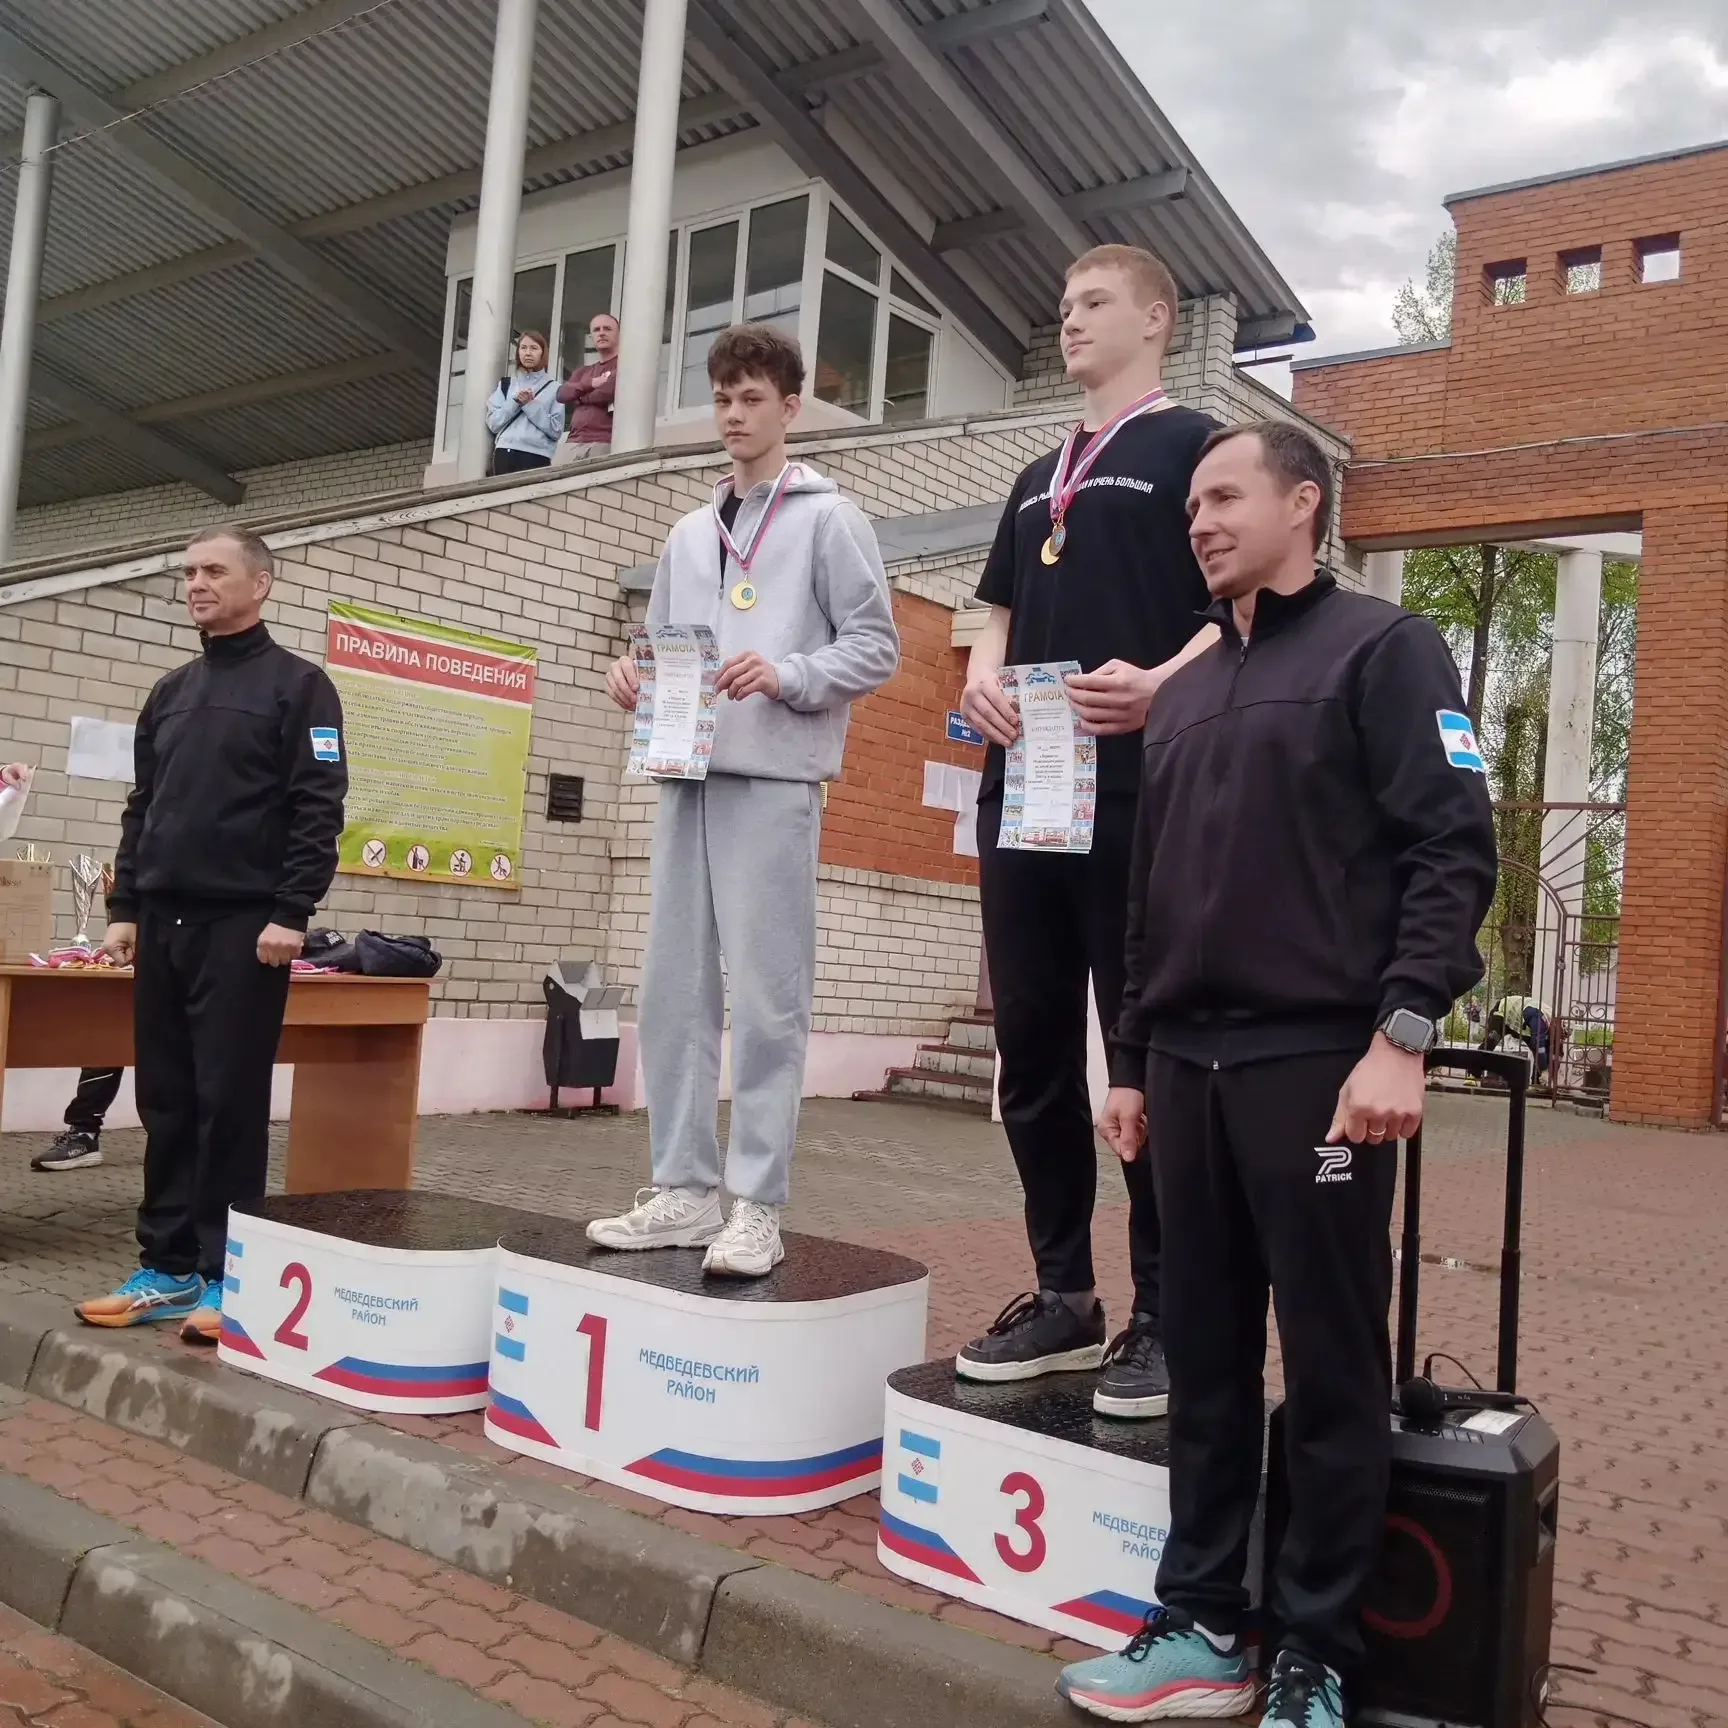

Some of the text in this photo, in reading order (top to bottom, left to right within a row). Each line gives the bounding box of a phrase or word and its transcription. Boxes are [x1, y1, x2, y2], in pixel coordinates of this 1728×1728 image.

[1093, 476, 1115, 487] ОЧЕНЬ
[1114, 476, 1154, 494] БОЛЬШАЯ
[656, 643, 696, 653] ГРАМОТА
[336, 633, 421, 667] ПРАВИЛА
[426, 656, 527, 690] ПОВЕДЕНИЯ
[1024, 690, 1064, 702] ГРАМОТА
[1315, 1172, 1352, 1183] PATRICK
[274, 1261, 312, 1351] 2
[334, 1286, 419, 1311] МЕДВЕДЕВСКИЙ
[351, 1308, 387, 1326] РАЙОН
[576, 1313, 608, 1431] 1
[639, 1348, 760, 1383] МЕДВЕДЕВСКИЙ
[666, 1379, 716, 1403] РАЙОН
[993, 1471, 1047, 1573] 3
[1092, 1511, 1167, 1542] МЕДВЕДЕВ
[1122, 1540, 1161, 1561] РАЙО
